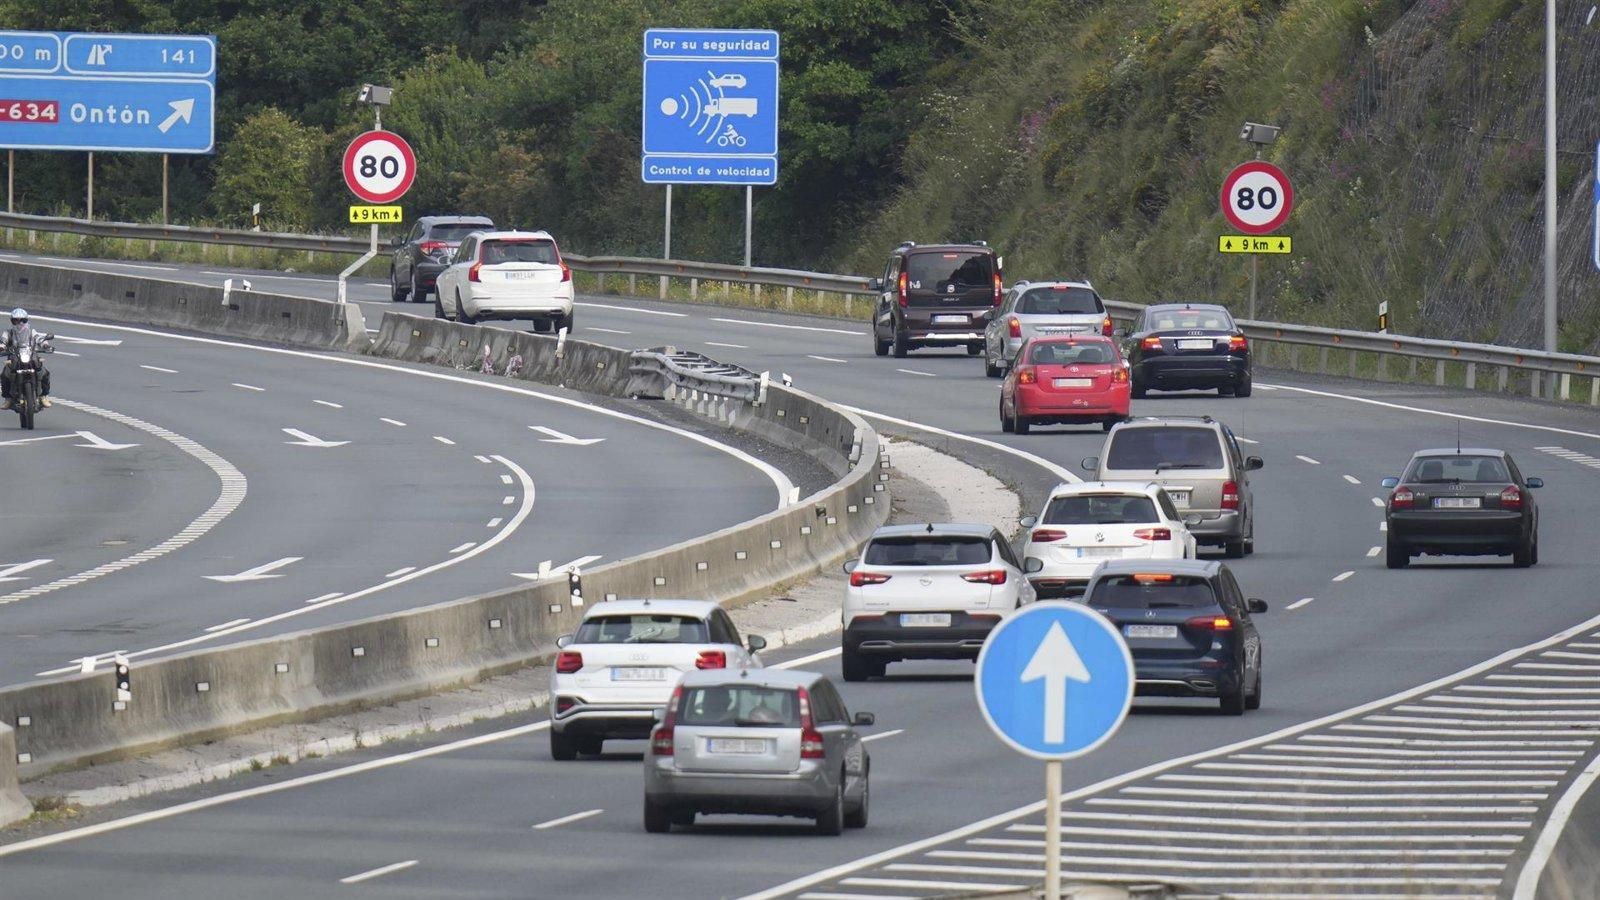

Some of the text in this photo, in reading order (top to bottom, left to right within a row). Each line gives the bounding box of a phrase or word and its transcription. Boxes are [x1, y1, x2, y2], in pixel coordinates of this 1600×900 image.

[653, 38, 770, 52] Por su seguridad
[35, 49, 50, 60] m
[162, 49, 195, 63] 141
[70, 103, 150, 124] Ontón
[360, 155, 399, 179] 80
[650, 165, 770, 176] Control de velocidad
[1237, 186, 1277, 210] 80
[362, 209, 390, 219] 9 km
[1243, 239, 1268, 249] 9 km
